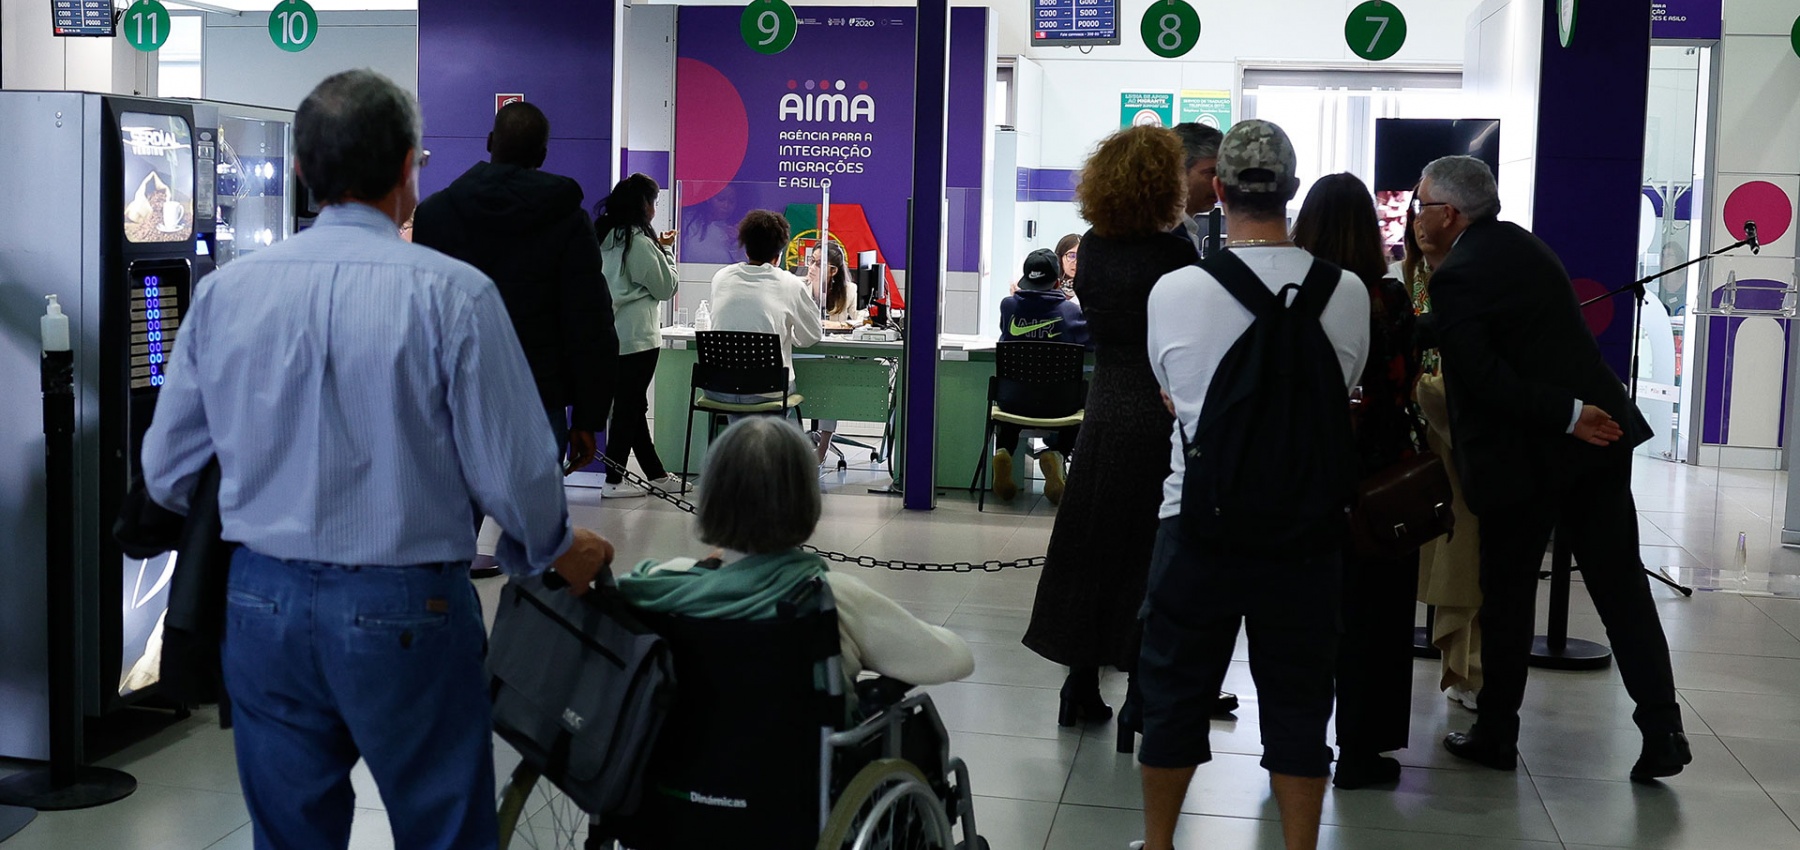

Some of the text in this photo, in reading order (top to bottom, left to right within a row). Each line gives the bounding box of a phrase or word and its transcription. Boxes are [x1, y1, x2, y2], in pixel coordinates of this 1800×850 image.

[132, 12, 157, 44] 11
[277, 11, 308, 45] 10
[757, 10, 780, 46] 9
[1157, 13, 1182, 50] 8
[1365, 16, 1389, 52] 7
[779, 93, 875, 123] AIMA
[779, 129, 872, 142] AGÊNCIA PARA A
[779, 144, 872, 160] INTEGRAÇÃO
[779, 160, 864, 175] MIGRAÇÕES
[778, 177, 832, 188] E ASILO
